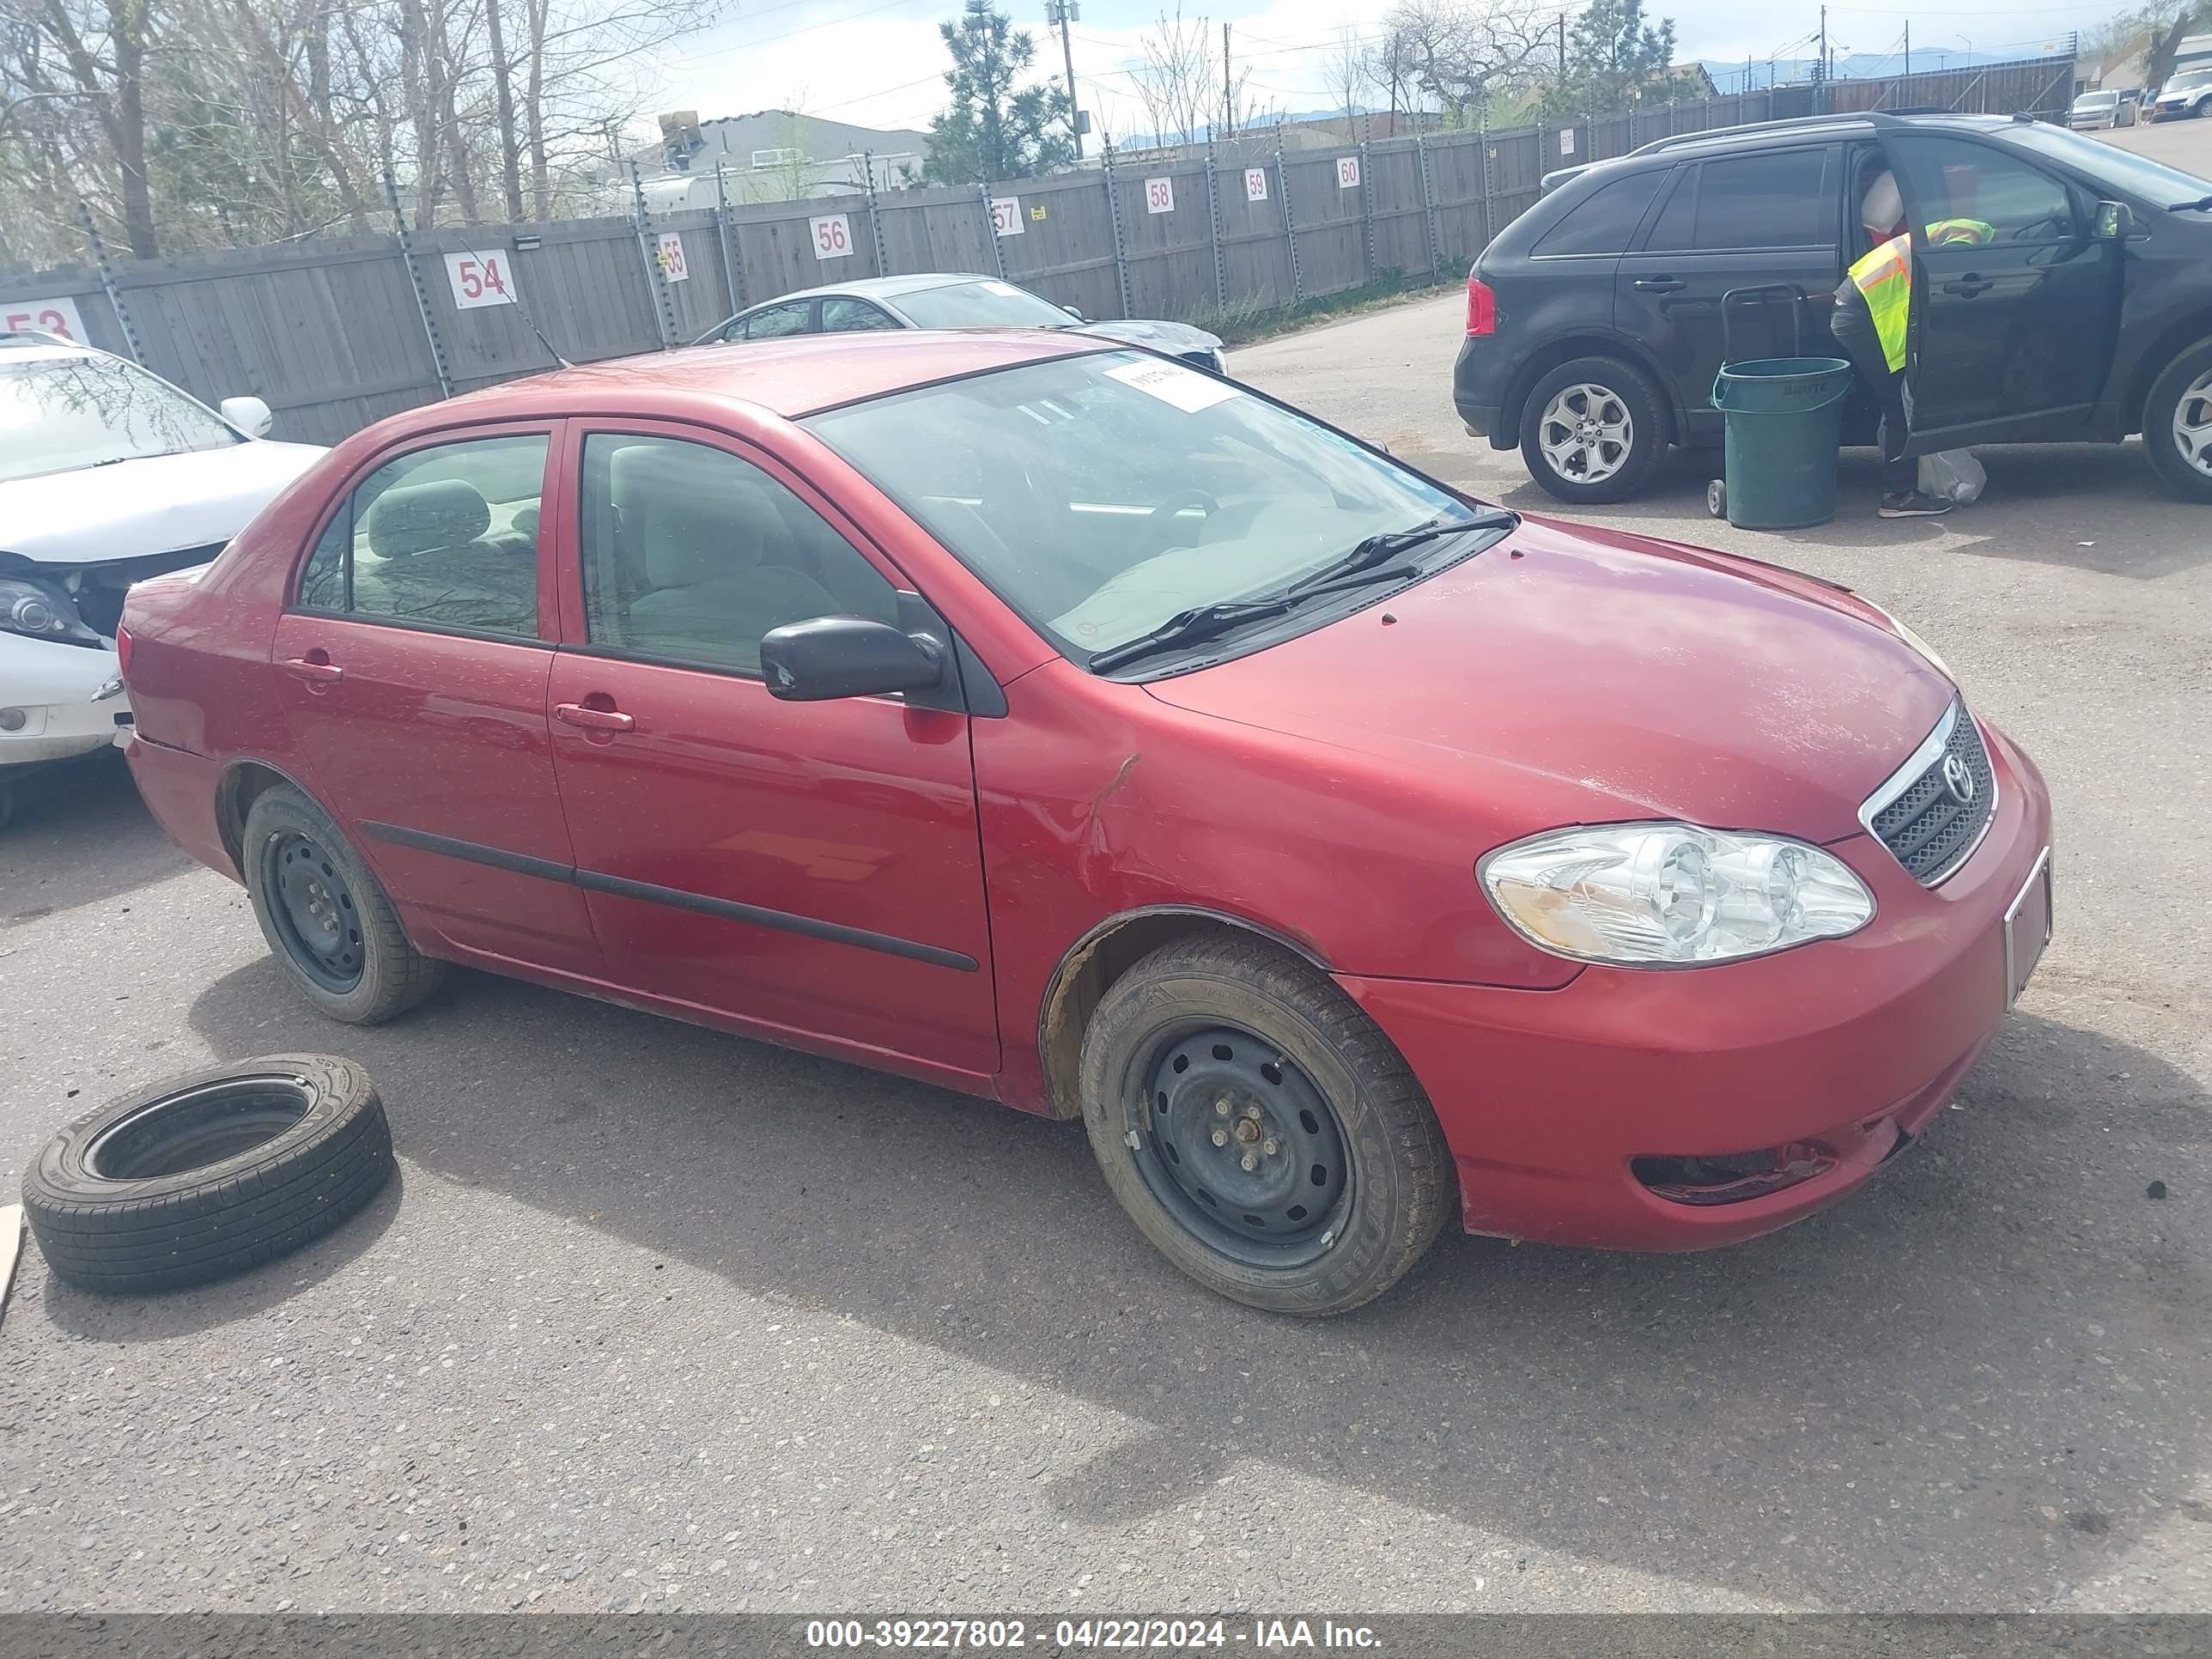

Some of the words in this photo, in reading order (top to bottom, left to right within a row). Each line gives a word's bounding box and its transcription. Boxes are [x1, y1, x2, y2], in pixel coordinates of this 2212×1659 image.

[1250, 173, 1263, 195] 59
[1341, 161, 1356, 182] 60
[1152, 183, 1169, 207] 58
[993, 203, 1014, 229] 57
[818, 221, 846, 252] 56
[665, 240, 683, 273] 55
[459, 258, 504, 298] 54
[1784, 383, 1829, 395] BRUTE
